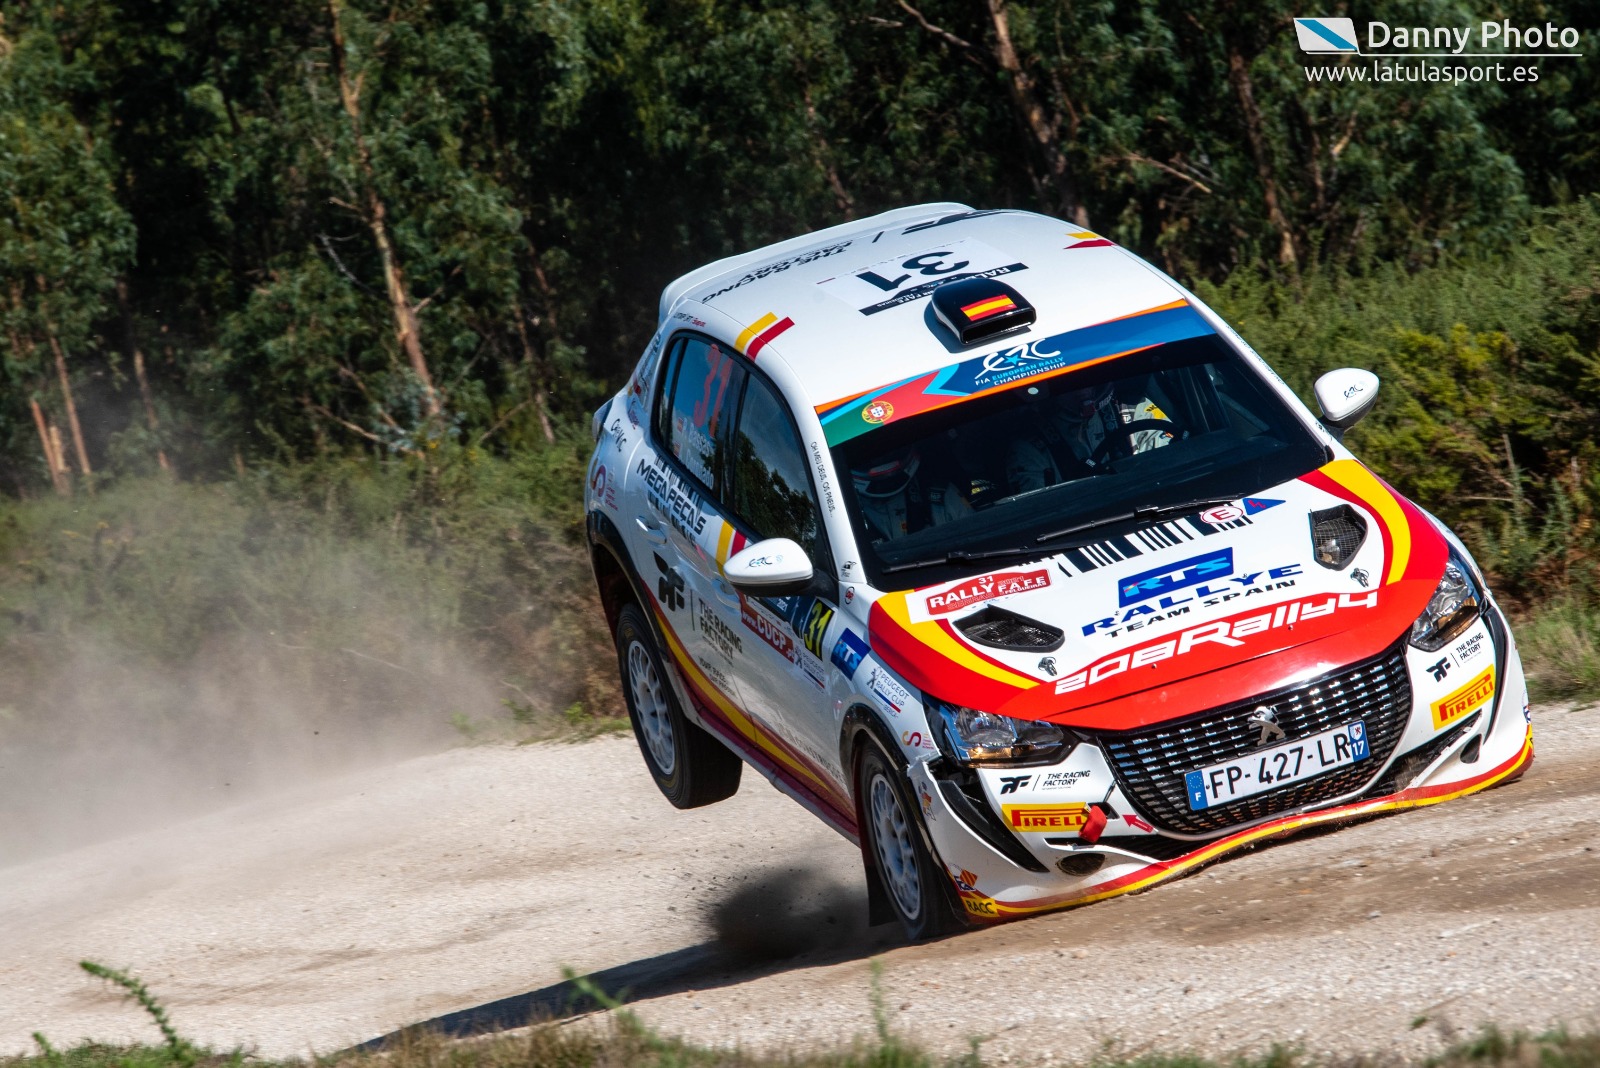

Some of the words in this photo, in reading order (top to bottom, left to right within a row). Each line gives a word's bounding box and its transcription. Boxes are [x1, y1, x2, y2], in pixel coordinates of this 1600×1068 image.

[855, 250, 970, 292] 31
[974, 338, 1062, 380] ERC
[975, 377, 991, 386] FIA
[991, 363, 1037, 381] EUROPEAN
[1038, 356, 1065, 369] RALLY
[993, 361, 1067, 386] CHAMPIONSHIP
[810, 441, 818, 452] OH
[813, 450, 822, 465] MEU
[822, 481, 831, 492] OS
[1210, 508, 1236, 521] E
[745, 554, 773, 569] ERC
[978, 575, 994, 585] 31
[1122, 556, 1232, 597] RTS
[929, 582, 995, 609] RALLY
[997, 575, 1046, 593] FAFE
[1080, 563, 1304, 637] RALLYE
[1104, 606, 1191, 639] TEAM
[1203, 579, 1297, 608] SPAIN
[700, 616, 734, 660] FACTORY
[714, 614, 743, 654] RACING
[804, 601, 832, 659] 31
[1456, 644, 1468, 654] THE
[1466, 632, 1485, 647] RACING
[834, 640, 863, 671] RTS
[1459, 642, 1482, 661] FACTORY
[875, 680, 892, 697] RALLY
[891, 693, 905, 708] CUP
[880, 671, 910, 700] PEUGEOT
[1439, 673, 1494, 722] PIRELLI
[1352, 740, 1365, 756] 17
[1047, 772, 1063, 780] THE
[1063, 769, 1092, 779] RACING
[1209, 732, 1351, 799] FP-427-LR
[1042, 778, 1078, 787] FACTORY
[1194, 791, 1202, 802] F
[1011, 807, 1088, 827] PIRELL
[965, 899, 996, 915] RACC
